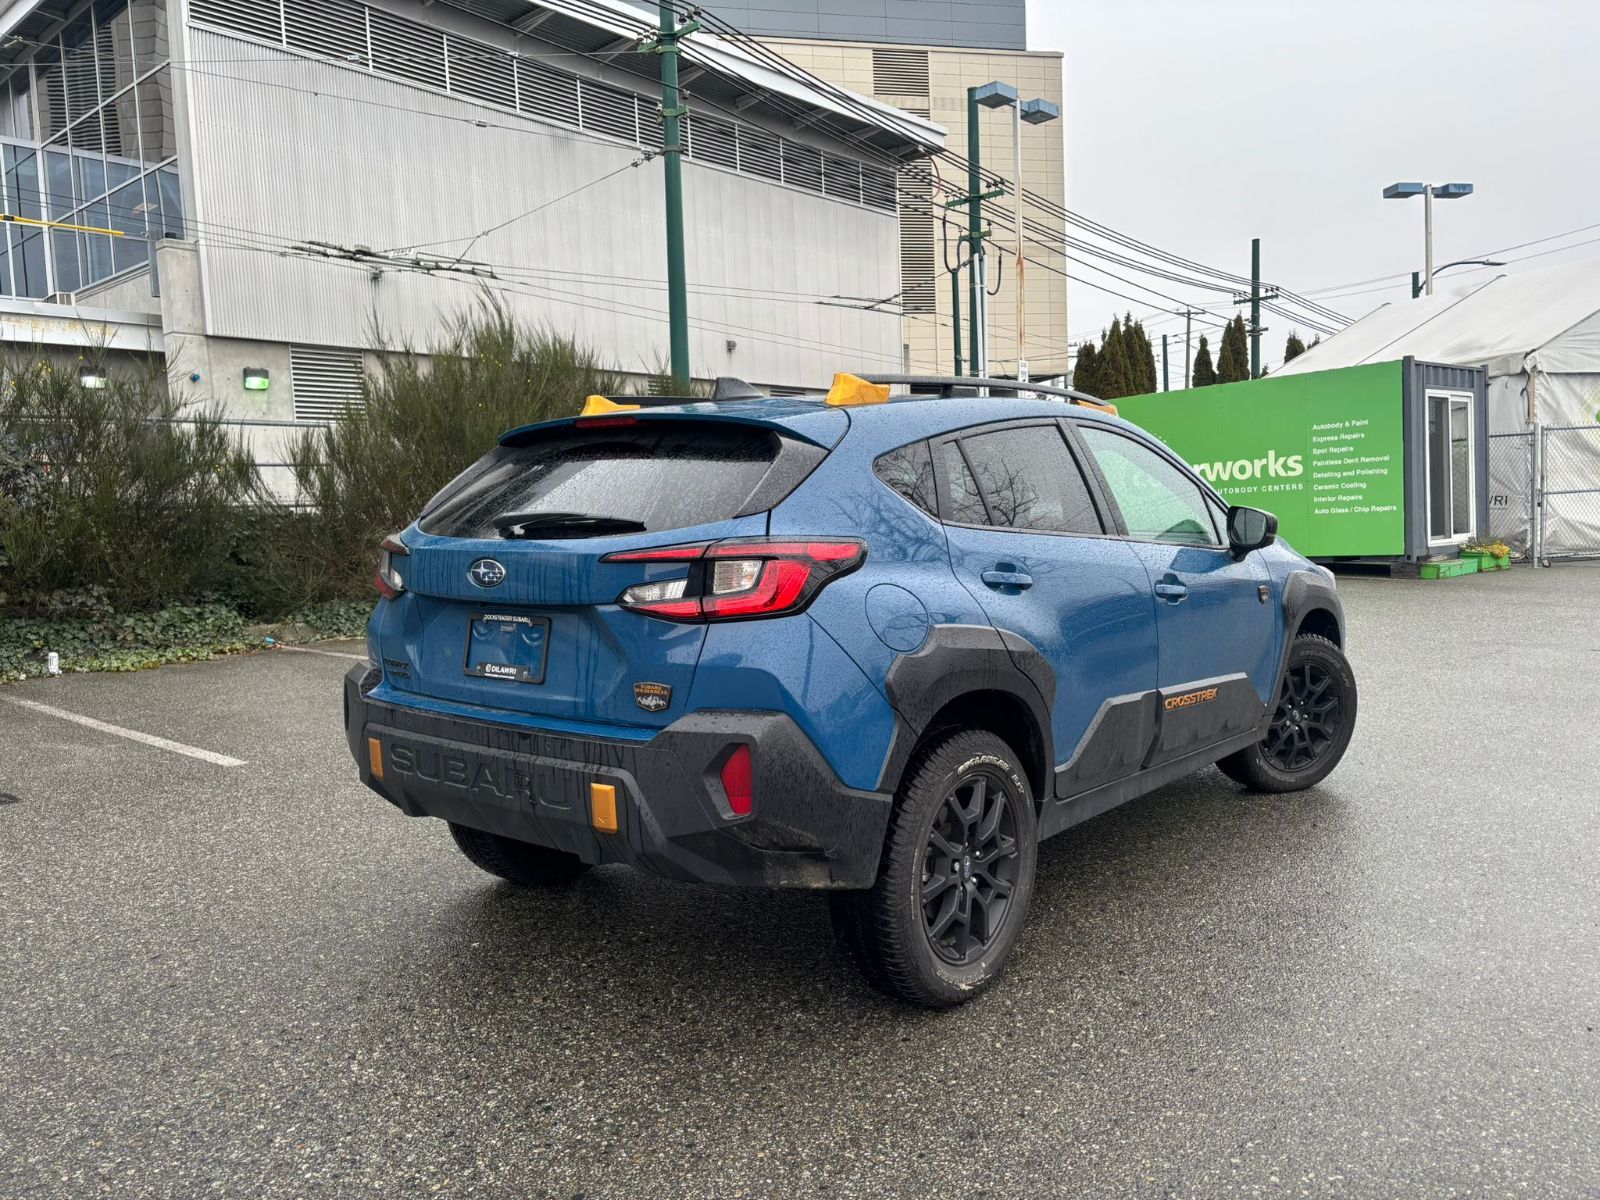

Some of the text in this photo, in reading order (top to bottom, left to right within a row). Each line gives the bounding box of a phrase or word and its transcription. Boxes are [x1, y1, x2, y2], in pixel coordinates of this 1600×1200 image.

[1312, 422, 1343, 431] Autobody
[1312, 432, 1365, 443] Express Repairs
[1329, 446, 1354, 454] Repairs
[1192, 450, 1304, 481] rworks
[1312, 459, 1342, 467] Paintless
[1360, 454, 1390, 463] Removal
[1313, 467, 1388, 479] Detailing and Polishing
[1217, 483, 1304, 494] UTOBODY CENTERS
[1313, 481, 1367, 491] Ceramic Coating
[1330, 506, 1349, 514] Glass
[1354, 505, 1370, 513] Chip
[1371, 504, 1397, 512] Repairs
[513, 615, 531, 623] SUBARU
[1164, 687, 1218, 710] CROSSTREK
[390, 744, 574, 811] SUBARU
